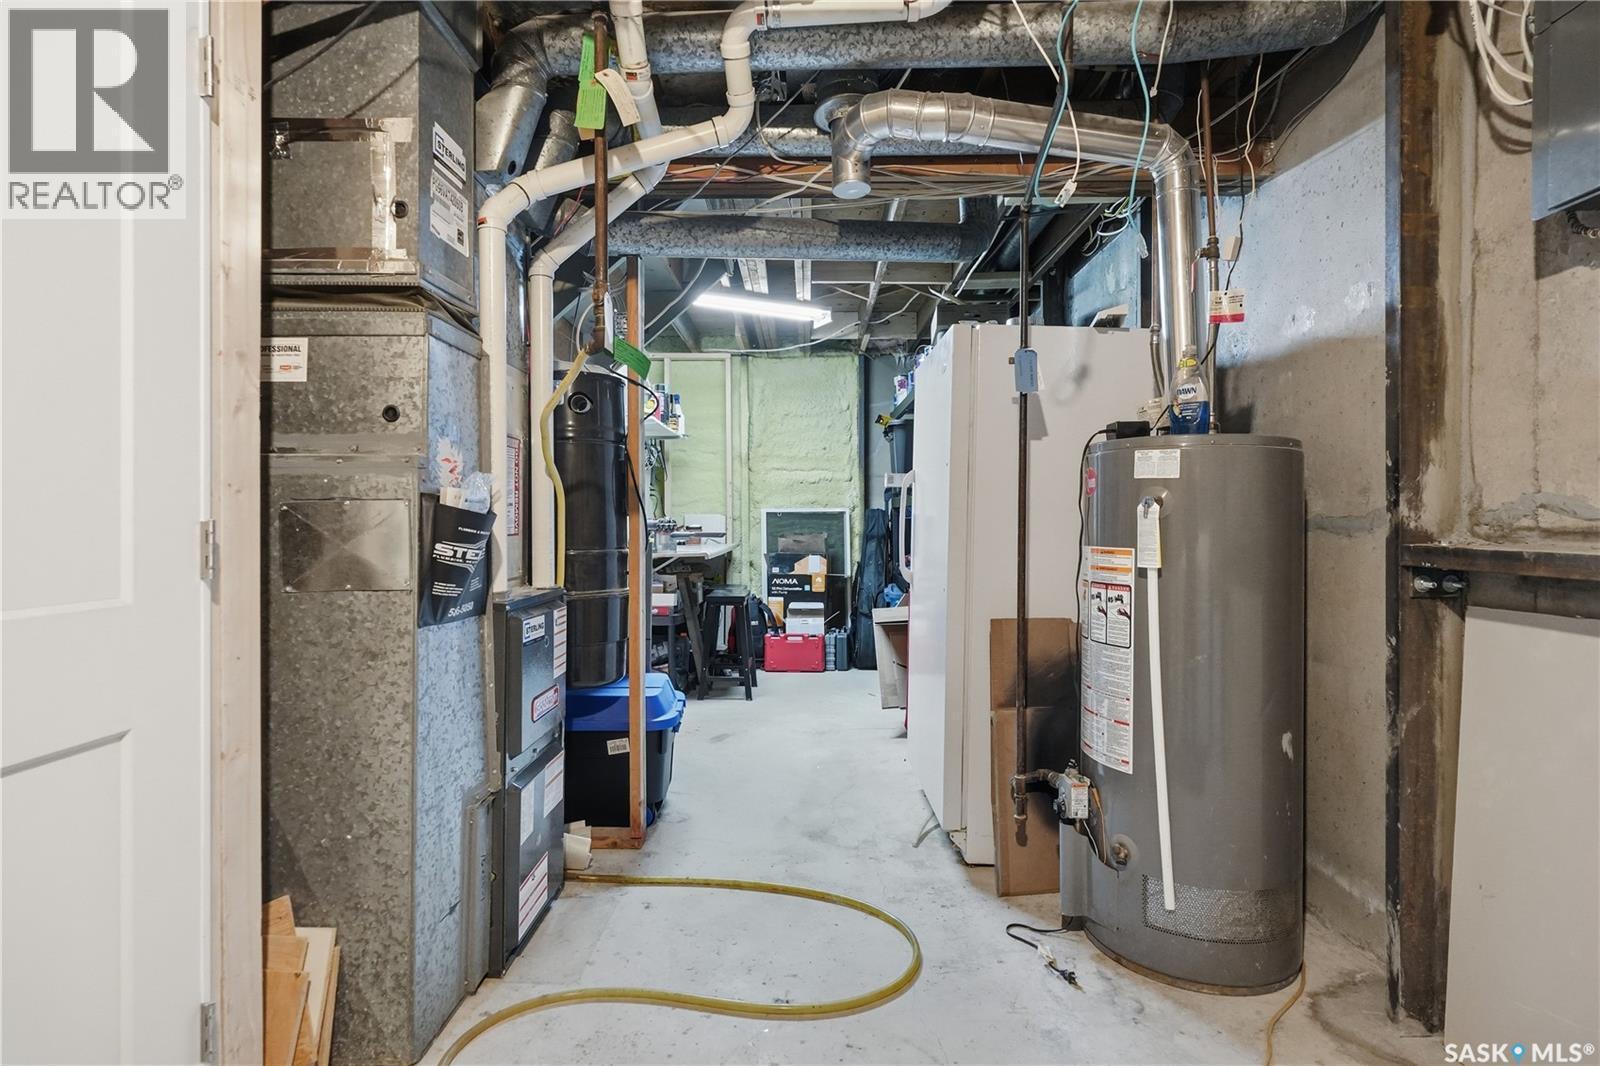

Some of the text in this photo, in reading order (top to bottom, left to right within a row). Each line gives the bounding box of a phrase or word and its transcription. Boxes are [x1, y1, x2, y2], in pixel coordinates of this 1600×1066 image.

[437, 140, 465, 172] STERLING
[1176, 387, 1198, 395] DAWN
[525, 622, 545, 635] STERLING
